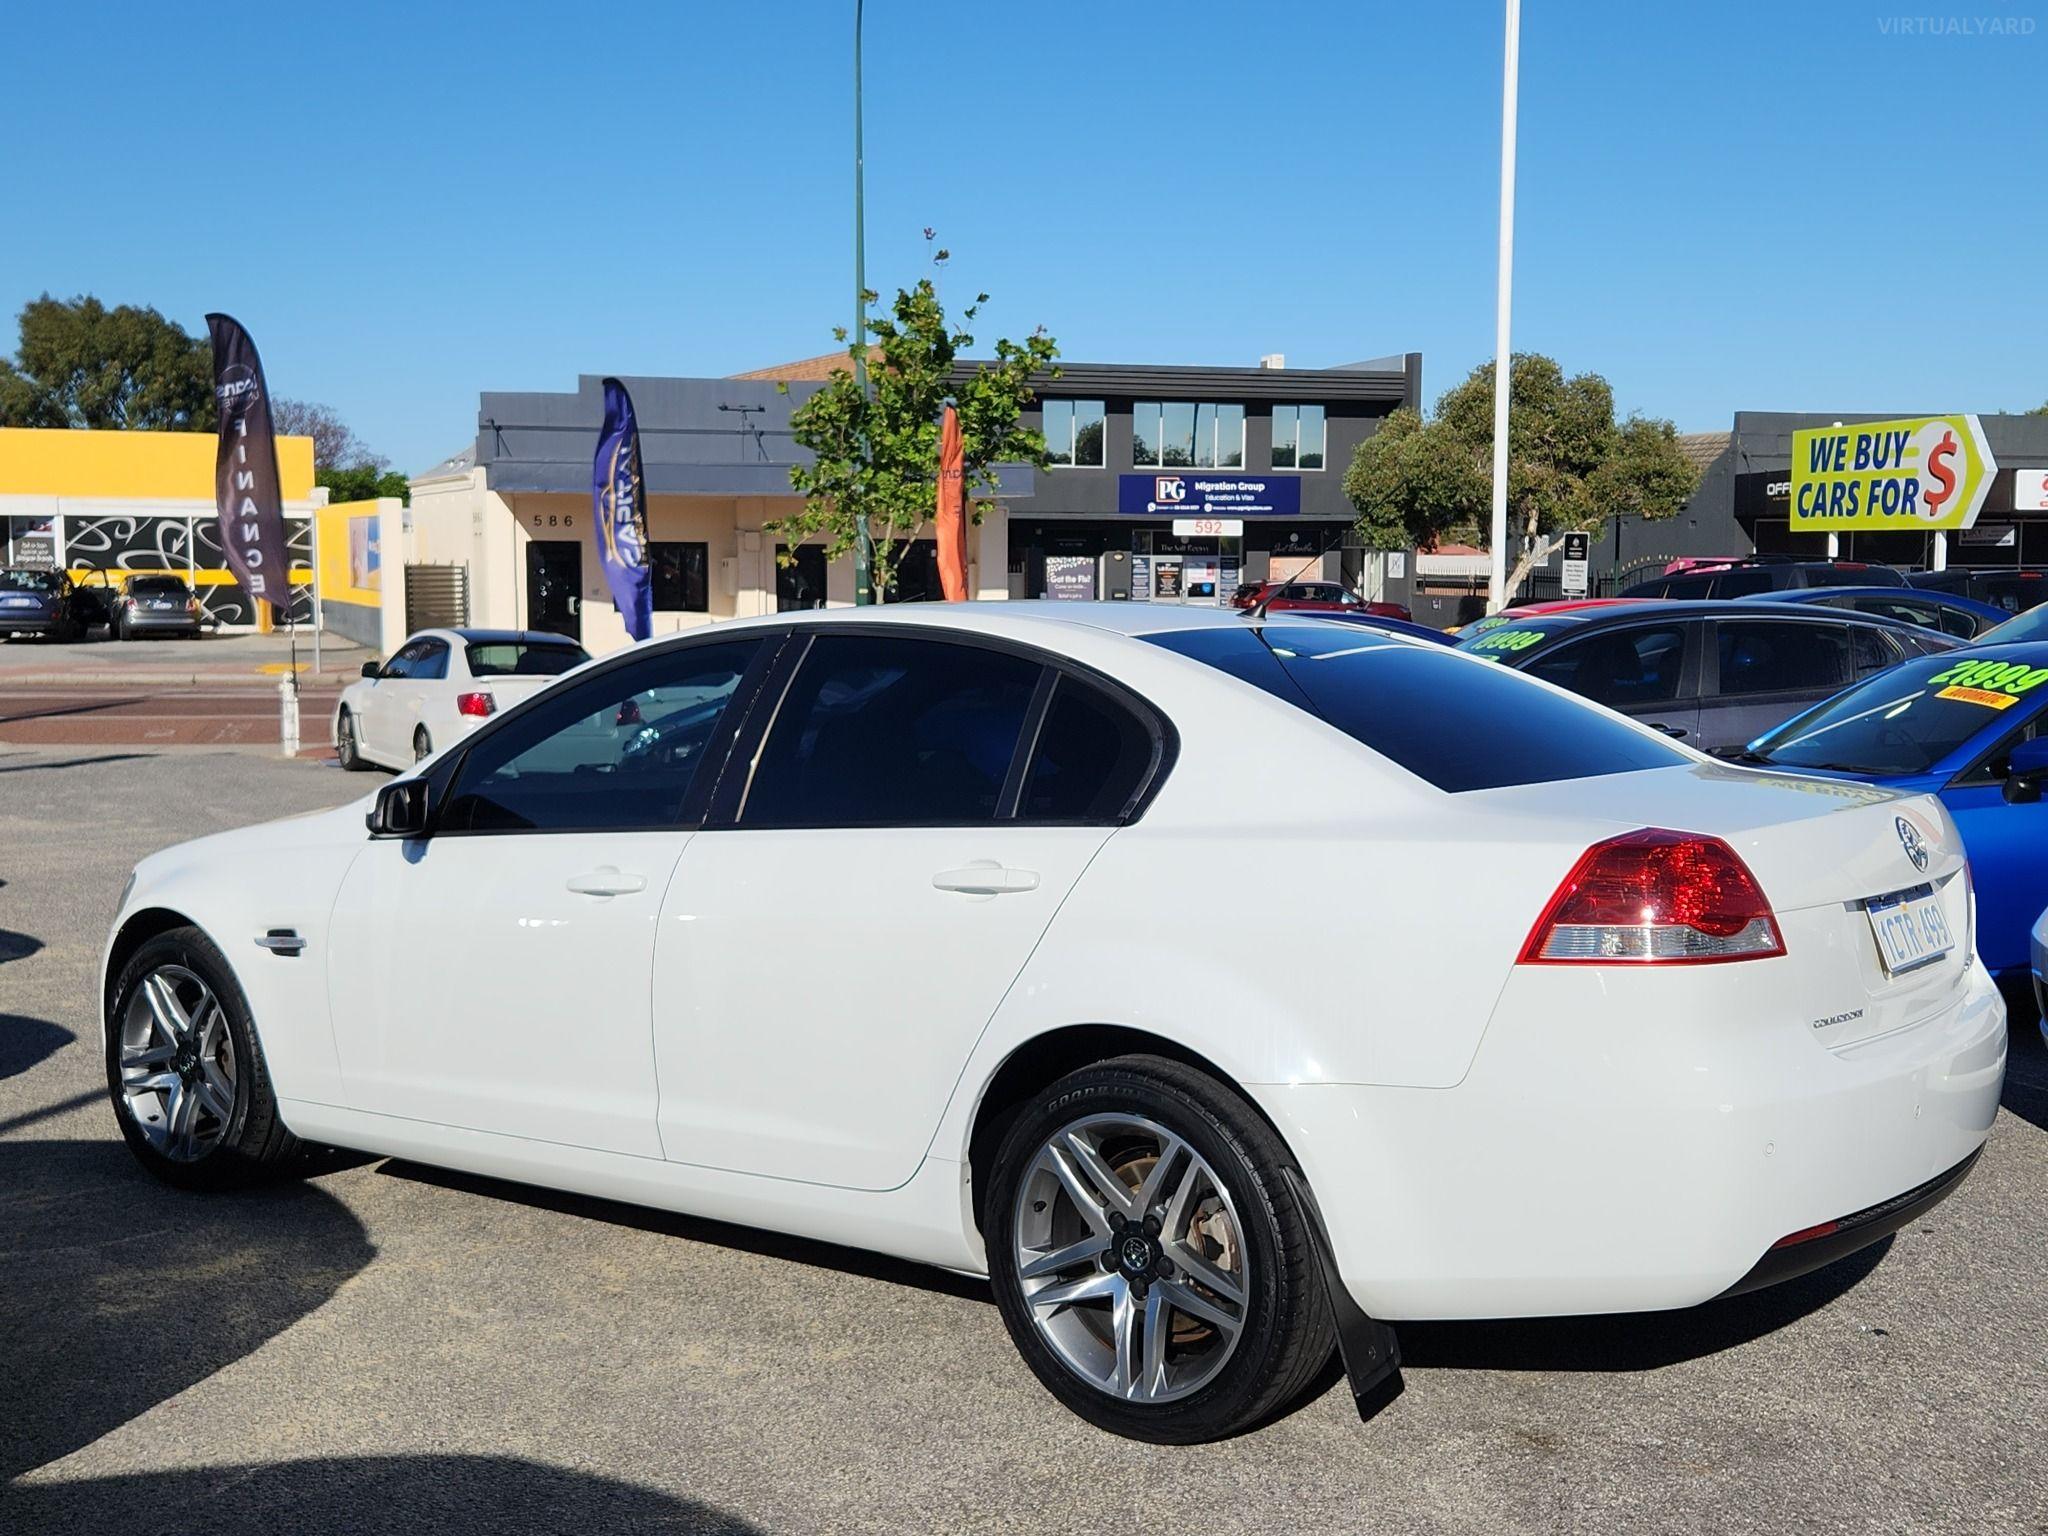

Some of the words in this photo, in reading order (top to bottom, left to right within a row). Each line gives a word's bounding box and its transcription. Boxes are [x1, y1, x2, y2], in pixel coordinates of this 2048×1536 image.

[1810, 435, 1848, 473] WE
[1854, 430, 1911, 471] BUY
[1195, 482, 1237, 492] Migration
[1238, 482, 1265, 492] Group
[1797, 480, 1861, 518] CARS
[1866, 477, 1920, 516] FOR
[1923, 430, 1957, 517] $
[1195, 521, 1223, 534] 592
[1927, 660, 2048, 694] 21999
[1879, 912, 1924, 963] 1CTR
[1918, 904, 1949, 949] 499
